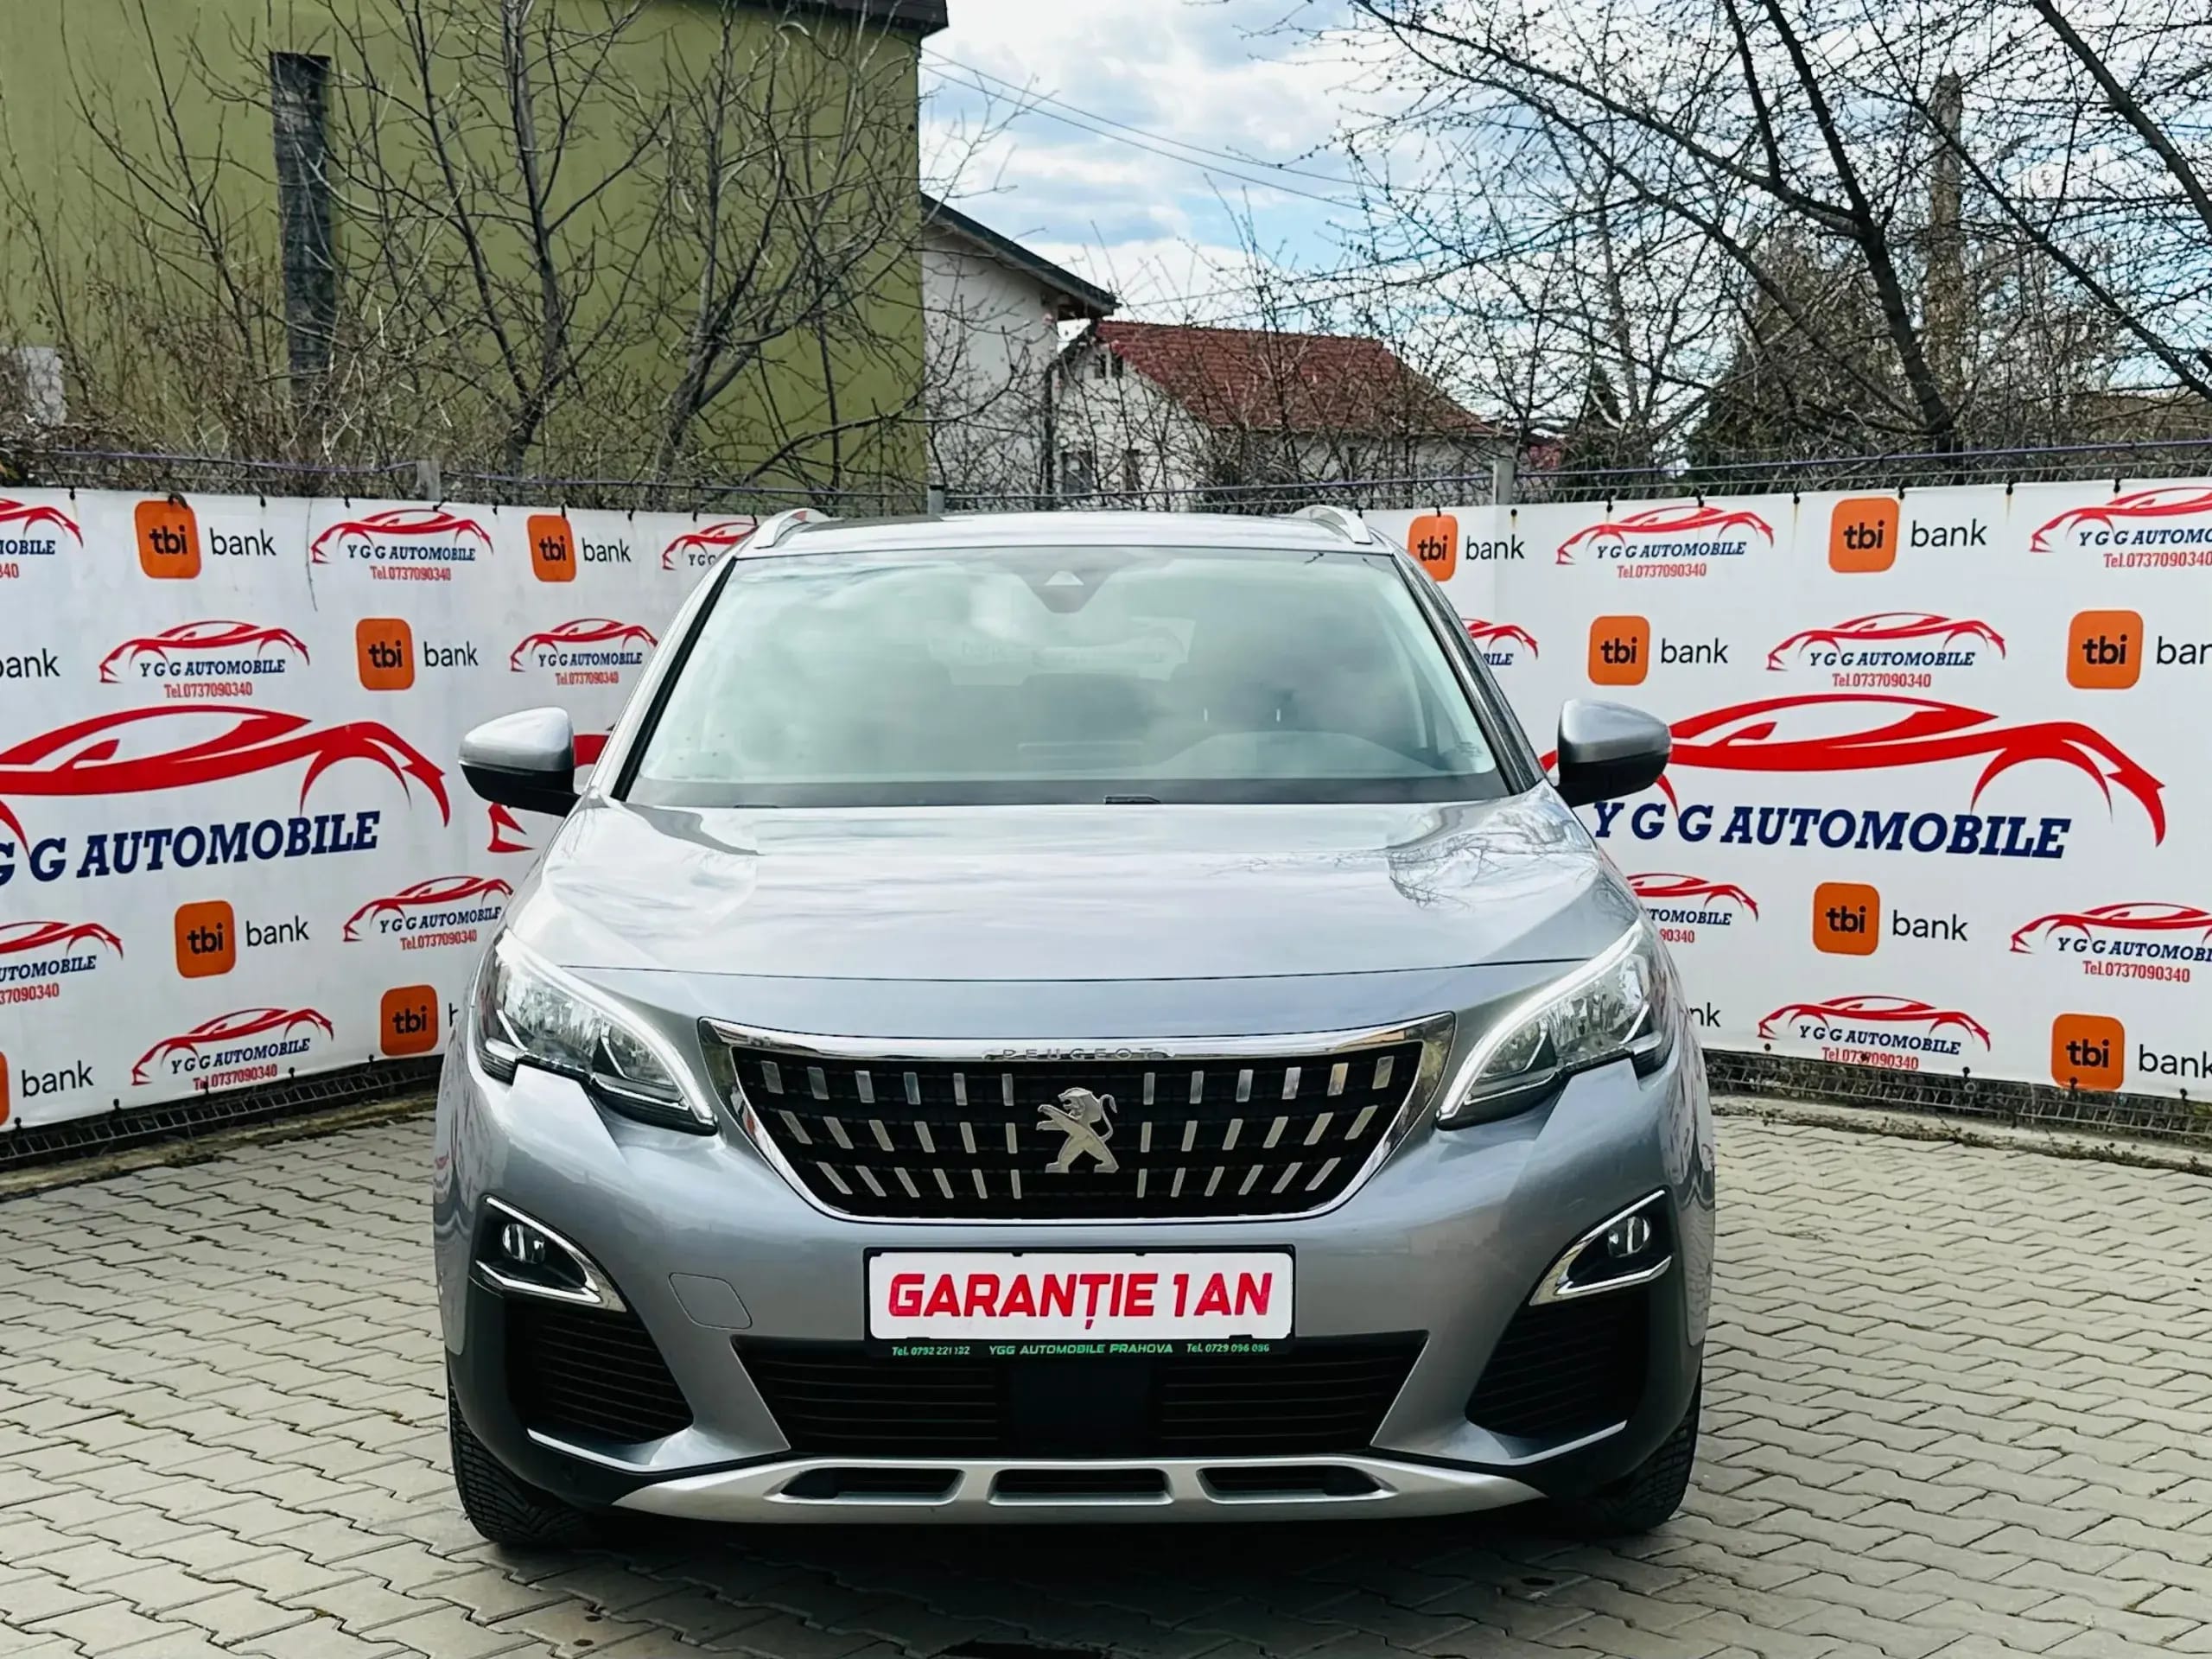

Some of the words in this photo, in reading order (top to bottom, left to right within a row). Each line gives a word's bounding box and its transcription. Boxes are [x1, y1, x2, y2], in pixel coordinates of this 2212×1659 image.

[149, 527, 188, 555] tbi
[211, 529, 276, 556] bank
[1844, 521, 1884, 550] tbi
[1911, 519, 1987, 547] bank
[389, 546, 475, 561] AUTOMOBILE
[539, 536, 566, 562] tbi
[582, 538, 631, 563] bank
[1417, 536, 1447, 561] tbi
[1465, 535, 1524, 560] bank
[1639, 542, 1746, 556] AUTOMOBILE
[2104, 552, 2212, 568] Tel.0737090340
[370, 566, 451, 581] Tel.0737090340
[1618, 563, 1707, 578] Tel.0737090340
[368, 640, 402, 667] tbi
[424, 641, 478, 666] bank
[570, 652, 642, 665] AUTOMOBILE
[1601, 638, 1637, 664] tbi
[1661, 638, 1728, 664] bank
[1856, 652, 1975, 666] AUTOMOBILE
[2082, 634, 2127, 664] tbi
[184, 659, 285, 675] AUTOMOBILE
[164, 683, 252, 697] Tel.0737090340
[1833, 674, 1931, 687] Tel.0737090340
[1593, 802, 1624, 838] Y
[1631, 804, 1666, 840] G
[1678, 804, 1713, 842] G
[1720, 806, 2071, 859] AUTOMOBILE
[76, 811, 380, 878] AUTOMOBILE
[419, 906, 502, 929] AUTOMOBILE
[1647, 908, 1732, 925] TOMOBILE
[1826, 906, 1866, 933] tbi
[1892, 910, 1967, 941] bank
[188, 922, 224, 954] tbi
[246, 916, 309, 946] bank
[2082, 960, 2190, 982] Tel.0737090340
[392, 1006, 427, 1033] tbi
[213, 1038, 310, 1067] AUTOMOBILE
[1845, 1030, 1961, 1055] AUTOMOBILE
[2067, 1039, 2109, 1067] tbi
[22, 1060, 93, 1097] bank
[888, 1273, 1159, 1330] GARANȚIE
[1173, 1273, 1190, 1317] 1
[1193, 1273, 1273, 1317] AN
[989, 1345, 1015, 1355] YGG
[1020, 1344, 1105, 1354] AUTOMOBILE
[1109, 1344, 1173, 1353] PRAHOVA
